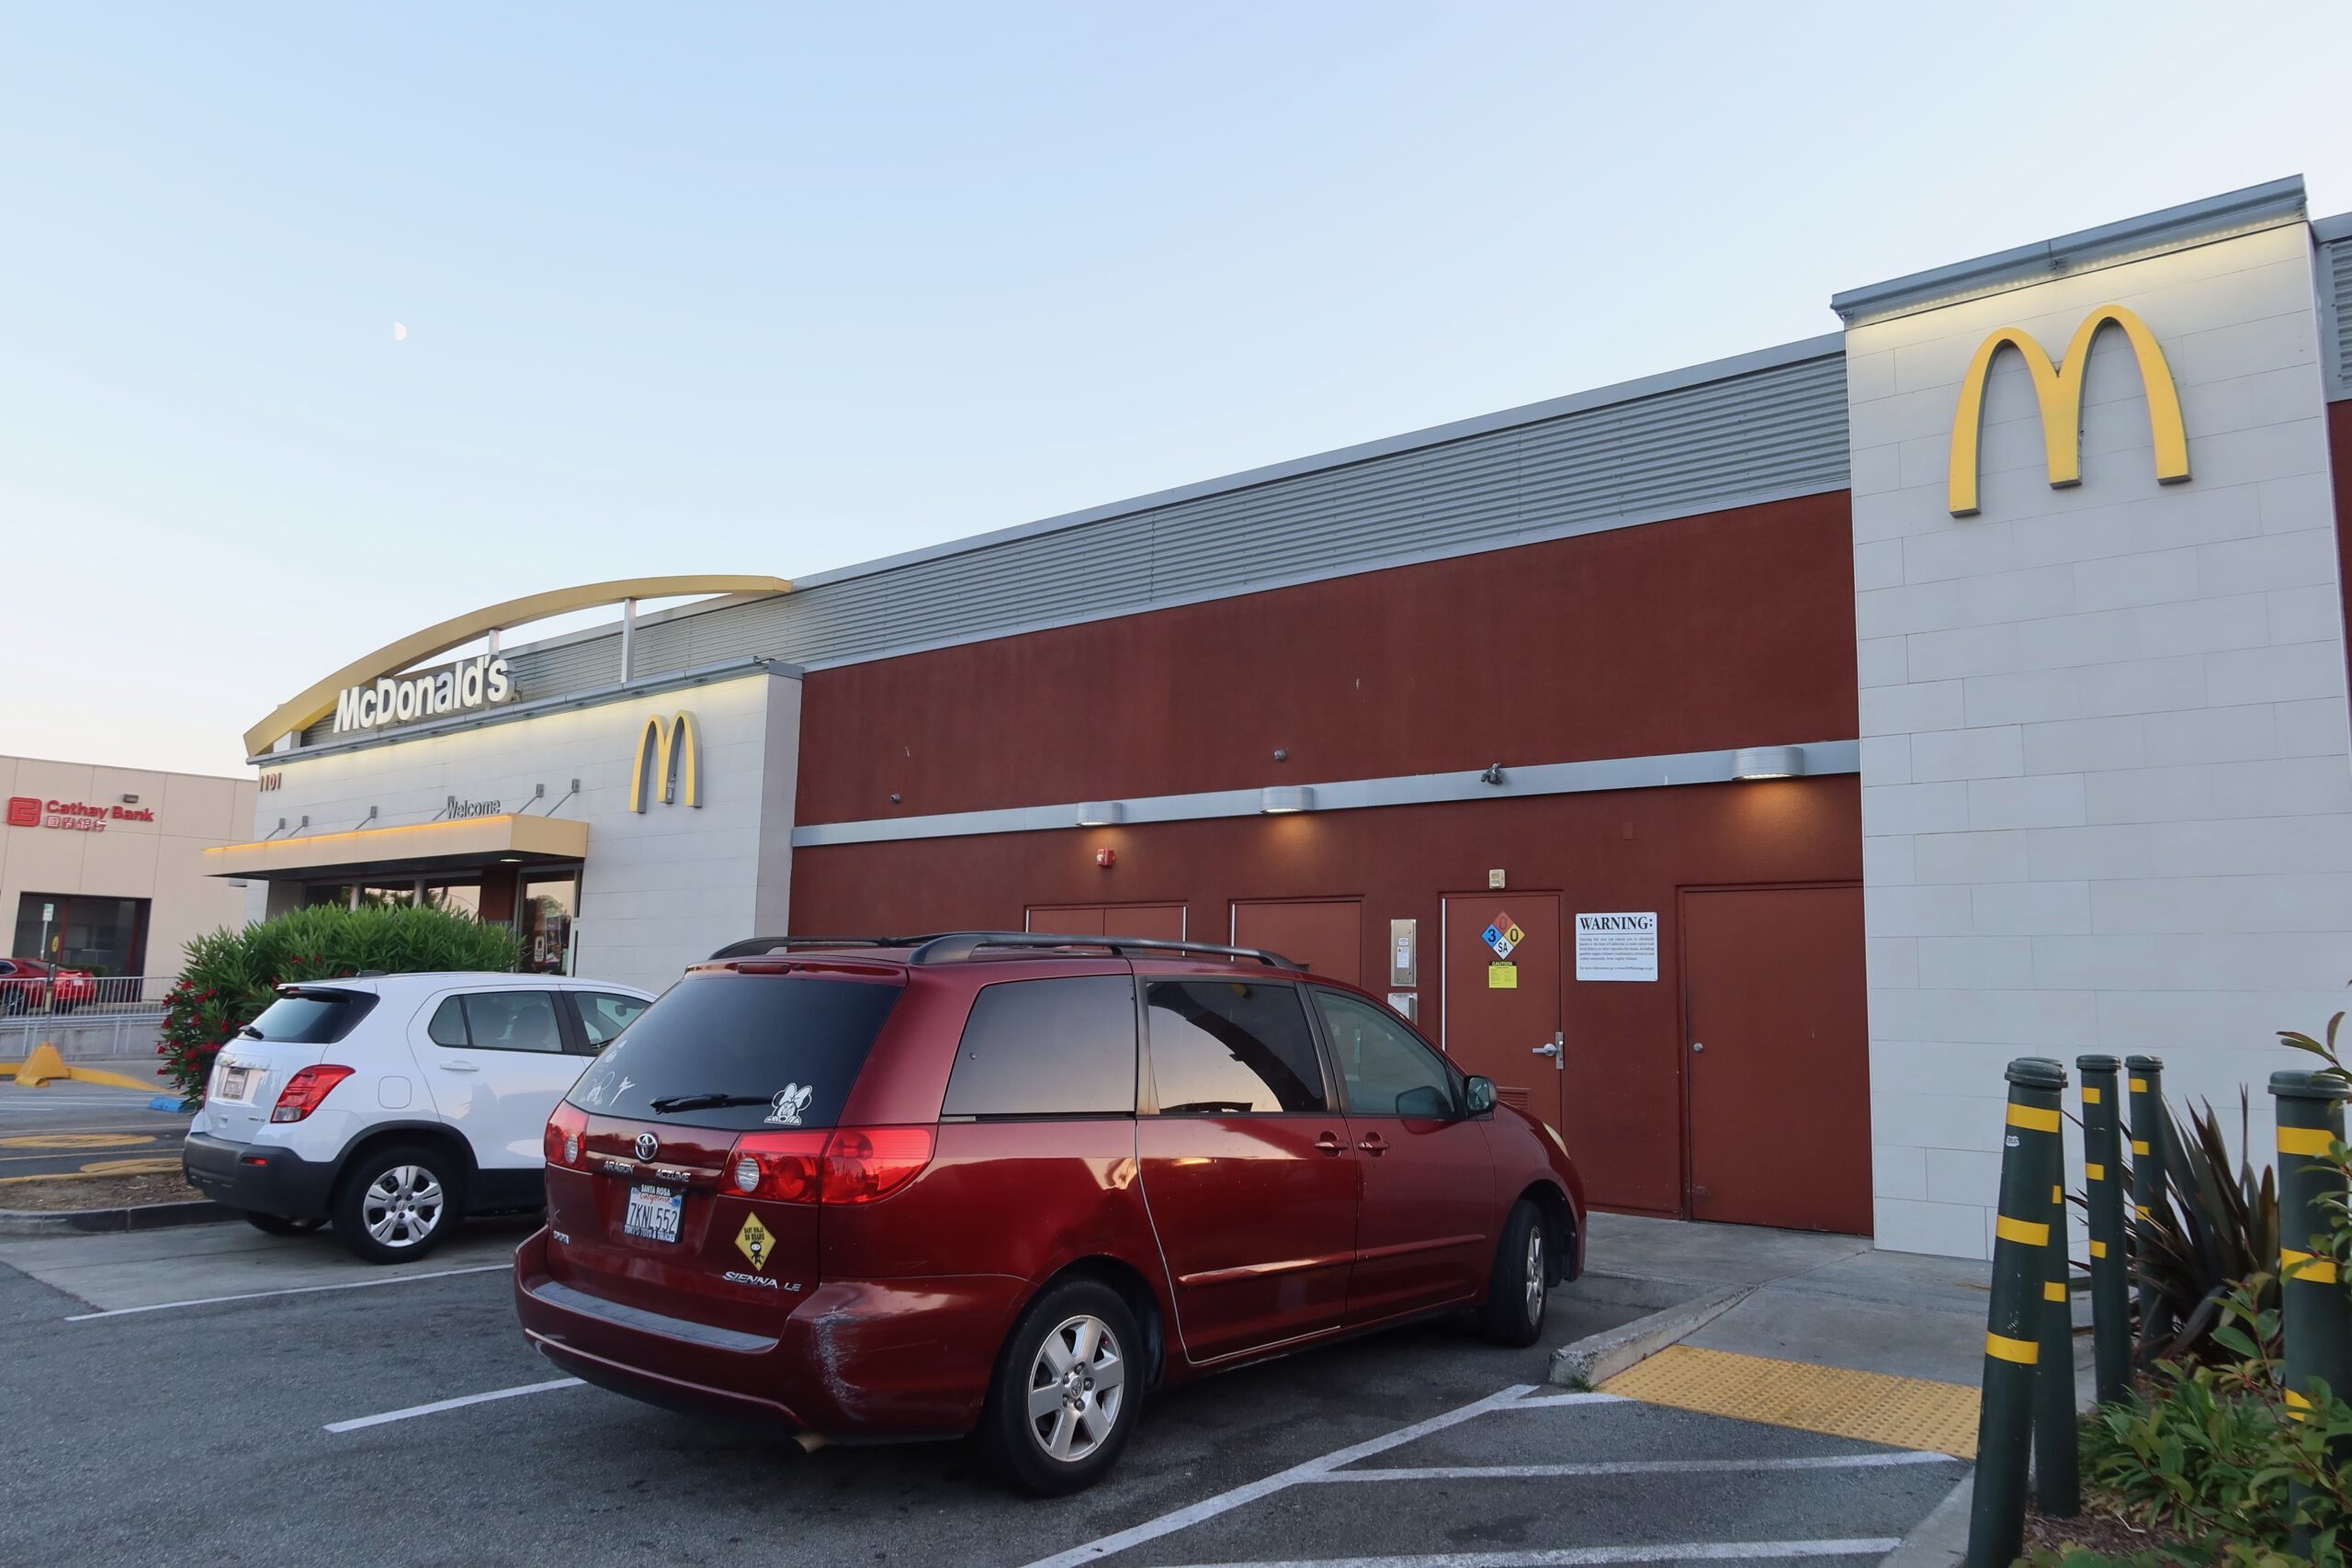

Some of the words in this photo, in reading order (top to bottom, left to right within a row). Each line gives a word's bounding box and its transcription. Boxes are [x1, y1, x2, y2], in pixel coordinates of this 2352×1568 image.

[333, 654, 510, 734] McDonald's
[260, 773, 282, 793] 1101
[46, 799, 107, 819] Cathay
[112, 805, 155, 822] Bank
[447, 799, 501, 819] Welcome
[1579, 916, 1653, 931] WARNING:
[1487, 929, 1497, 942] 3
[1510, 929, 1519, 942] 0
[1498, 942, 1509, 953] SA
[604, 1160, 635, 1174] ARAGON
[640, 1184, 655, 1195] SANTA
[656, 1187, 671, 1197] ROSA
[630, 1202, 678, 1235] 7KNL552
[722, 1270, 778, 1289] SIENNA
[784, 1282, 802, 1292] LE
